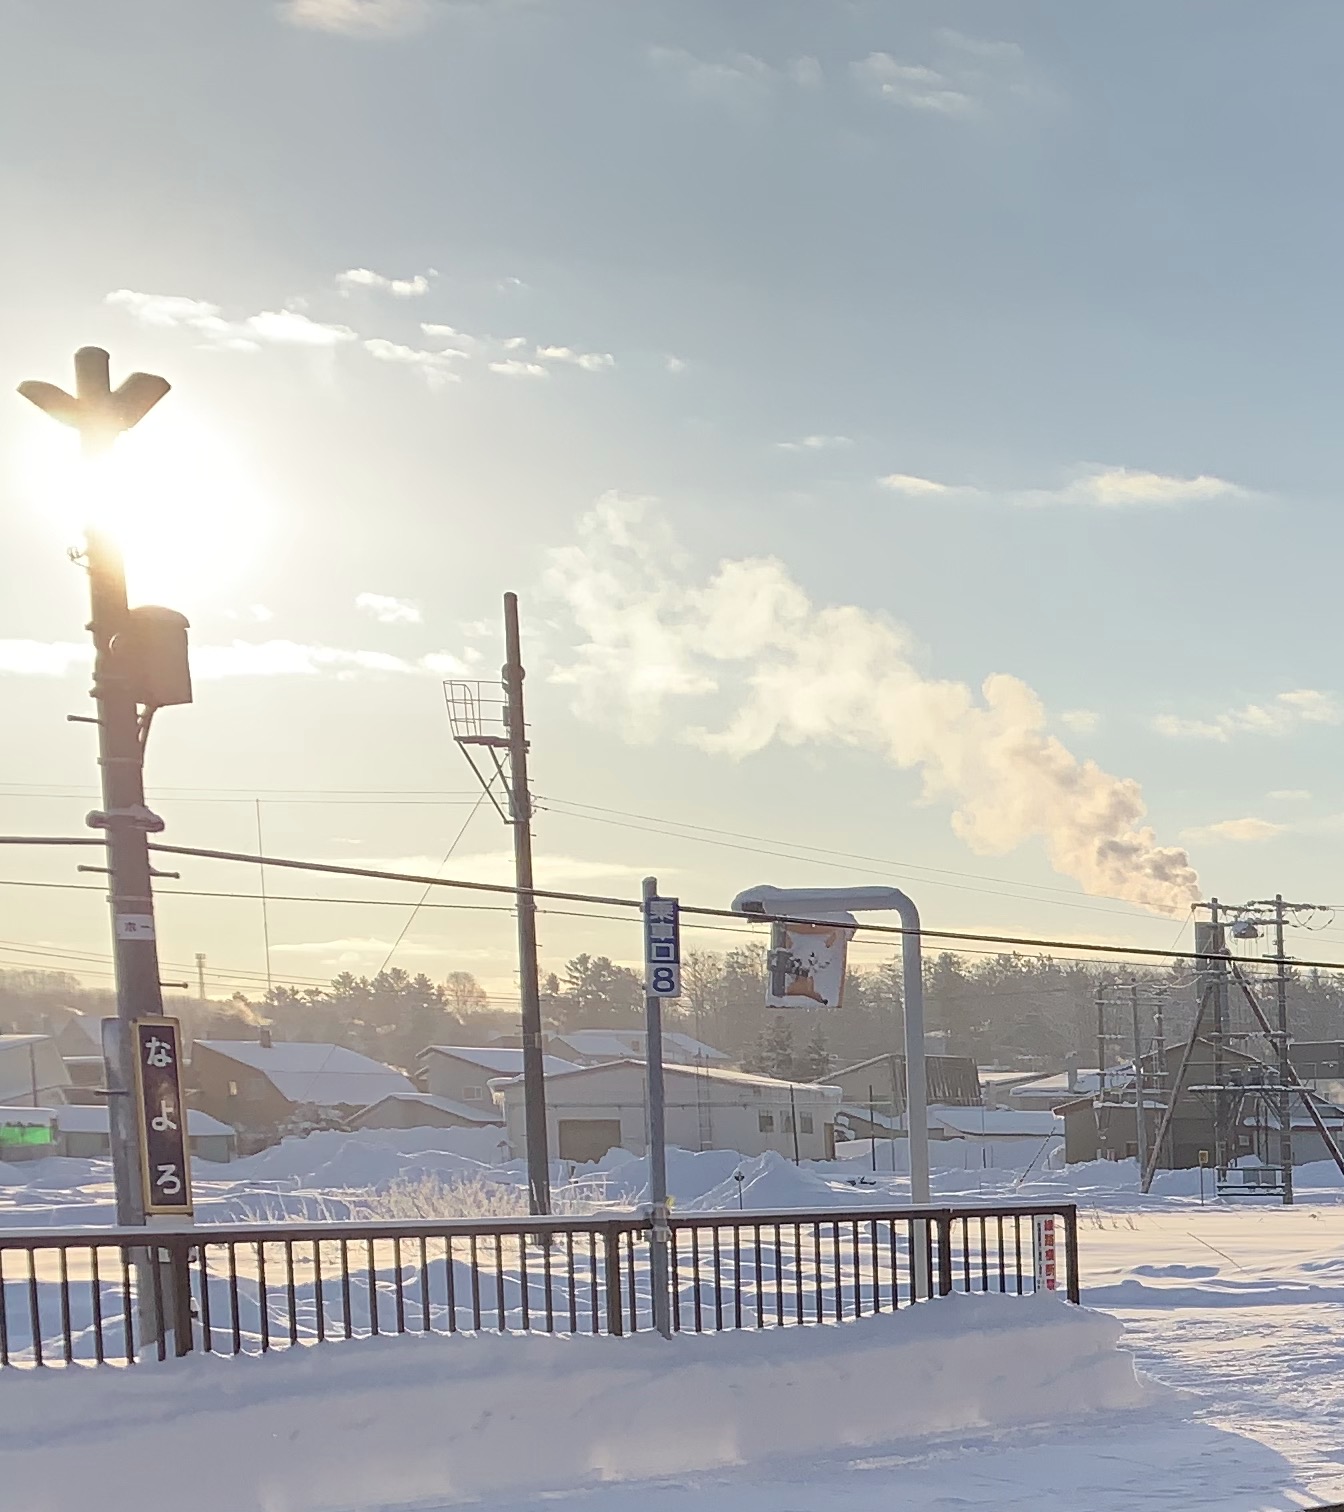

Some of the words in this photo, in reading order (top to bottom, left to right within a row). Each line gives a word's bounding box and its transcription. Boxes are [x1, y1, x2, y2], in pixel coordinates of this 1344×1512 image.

[650, 901, 675, 961] 乗車口
[652, 966, 675, 993] 8
[145, 1036, 181, 1196] なよろ
